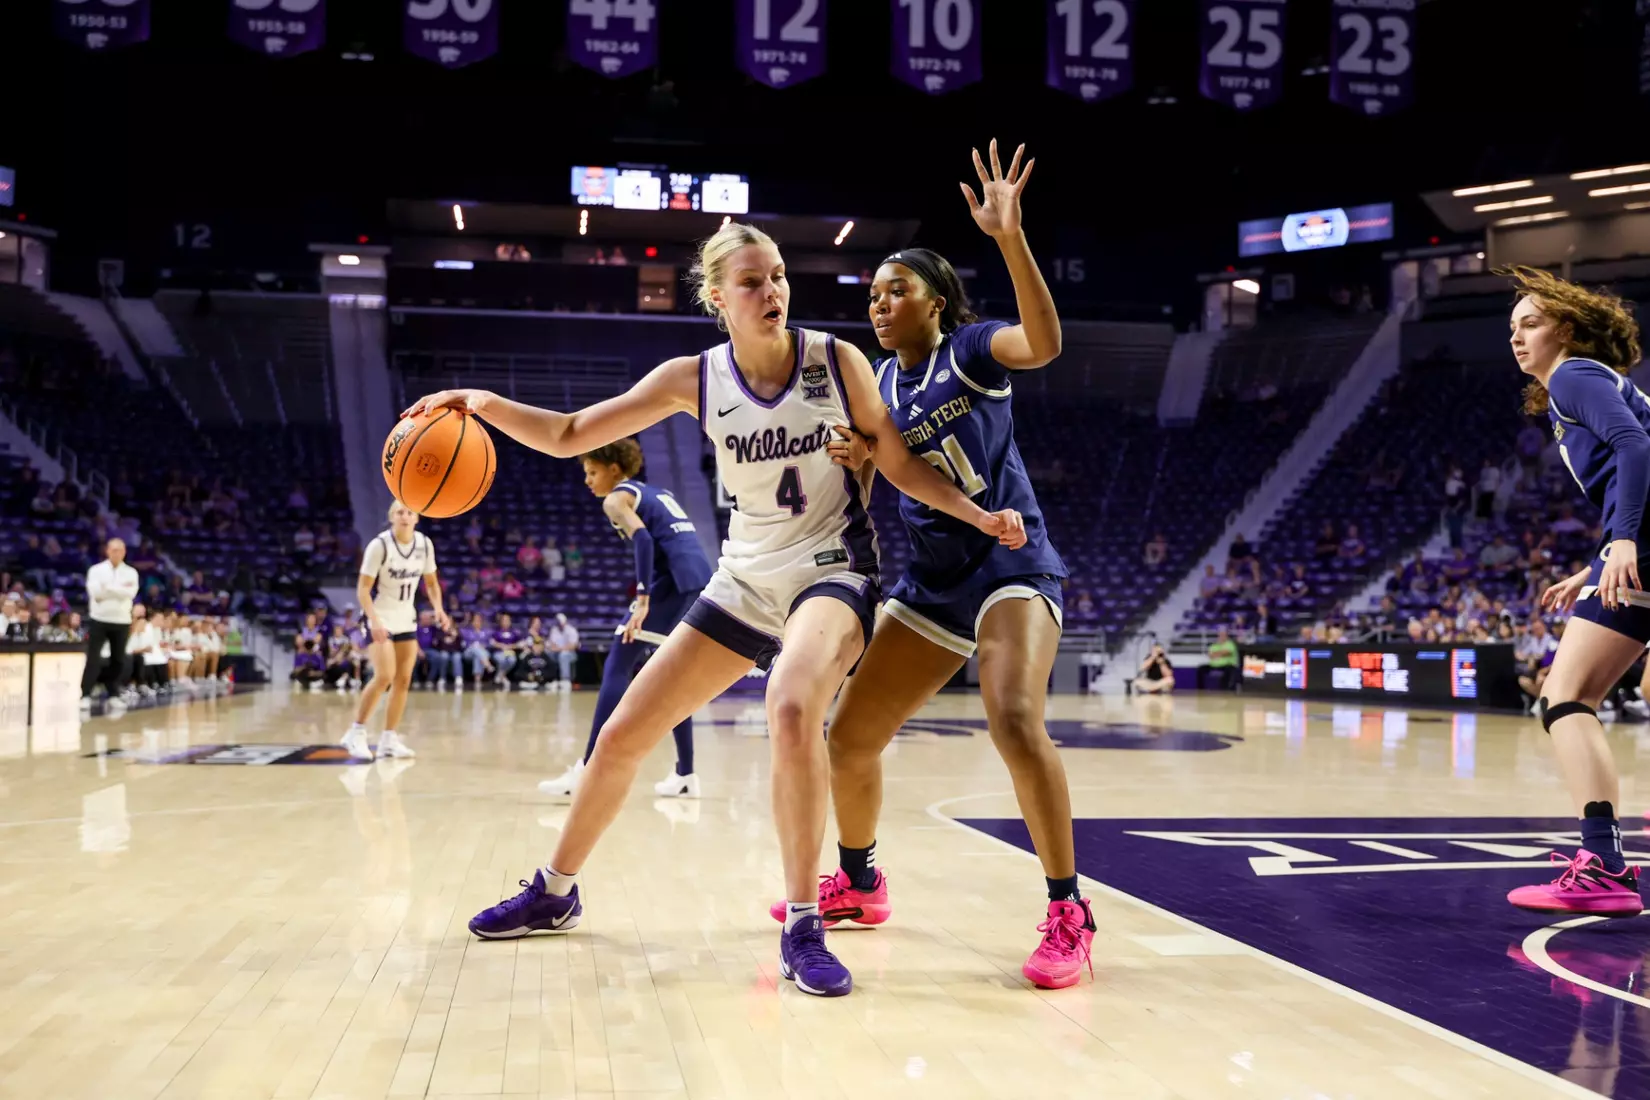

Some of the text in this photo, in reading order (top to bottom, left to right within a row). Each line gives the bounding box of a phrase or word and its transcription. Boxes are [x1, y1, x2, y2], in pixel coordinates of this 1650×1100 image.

[752, 0, 820, 44] 12
[898, 0, 975, 51] 10
[1055, 0, 1130, 60] 12
[1206, 5, 1283, 70] 25
[1337, 12, 1412, 77] 23
[173, 222, 213, 249] 12
[1051, 258, 1086, 282] 15
[725, 419, 832, 464] Wildcats
[901, 396, 972, 447] RGIA TECH
[775, 464, 808, 516] 4
[400, 583, 411, 601] 11
